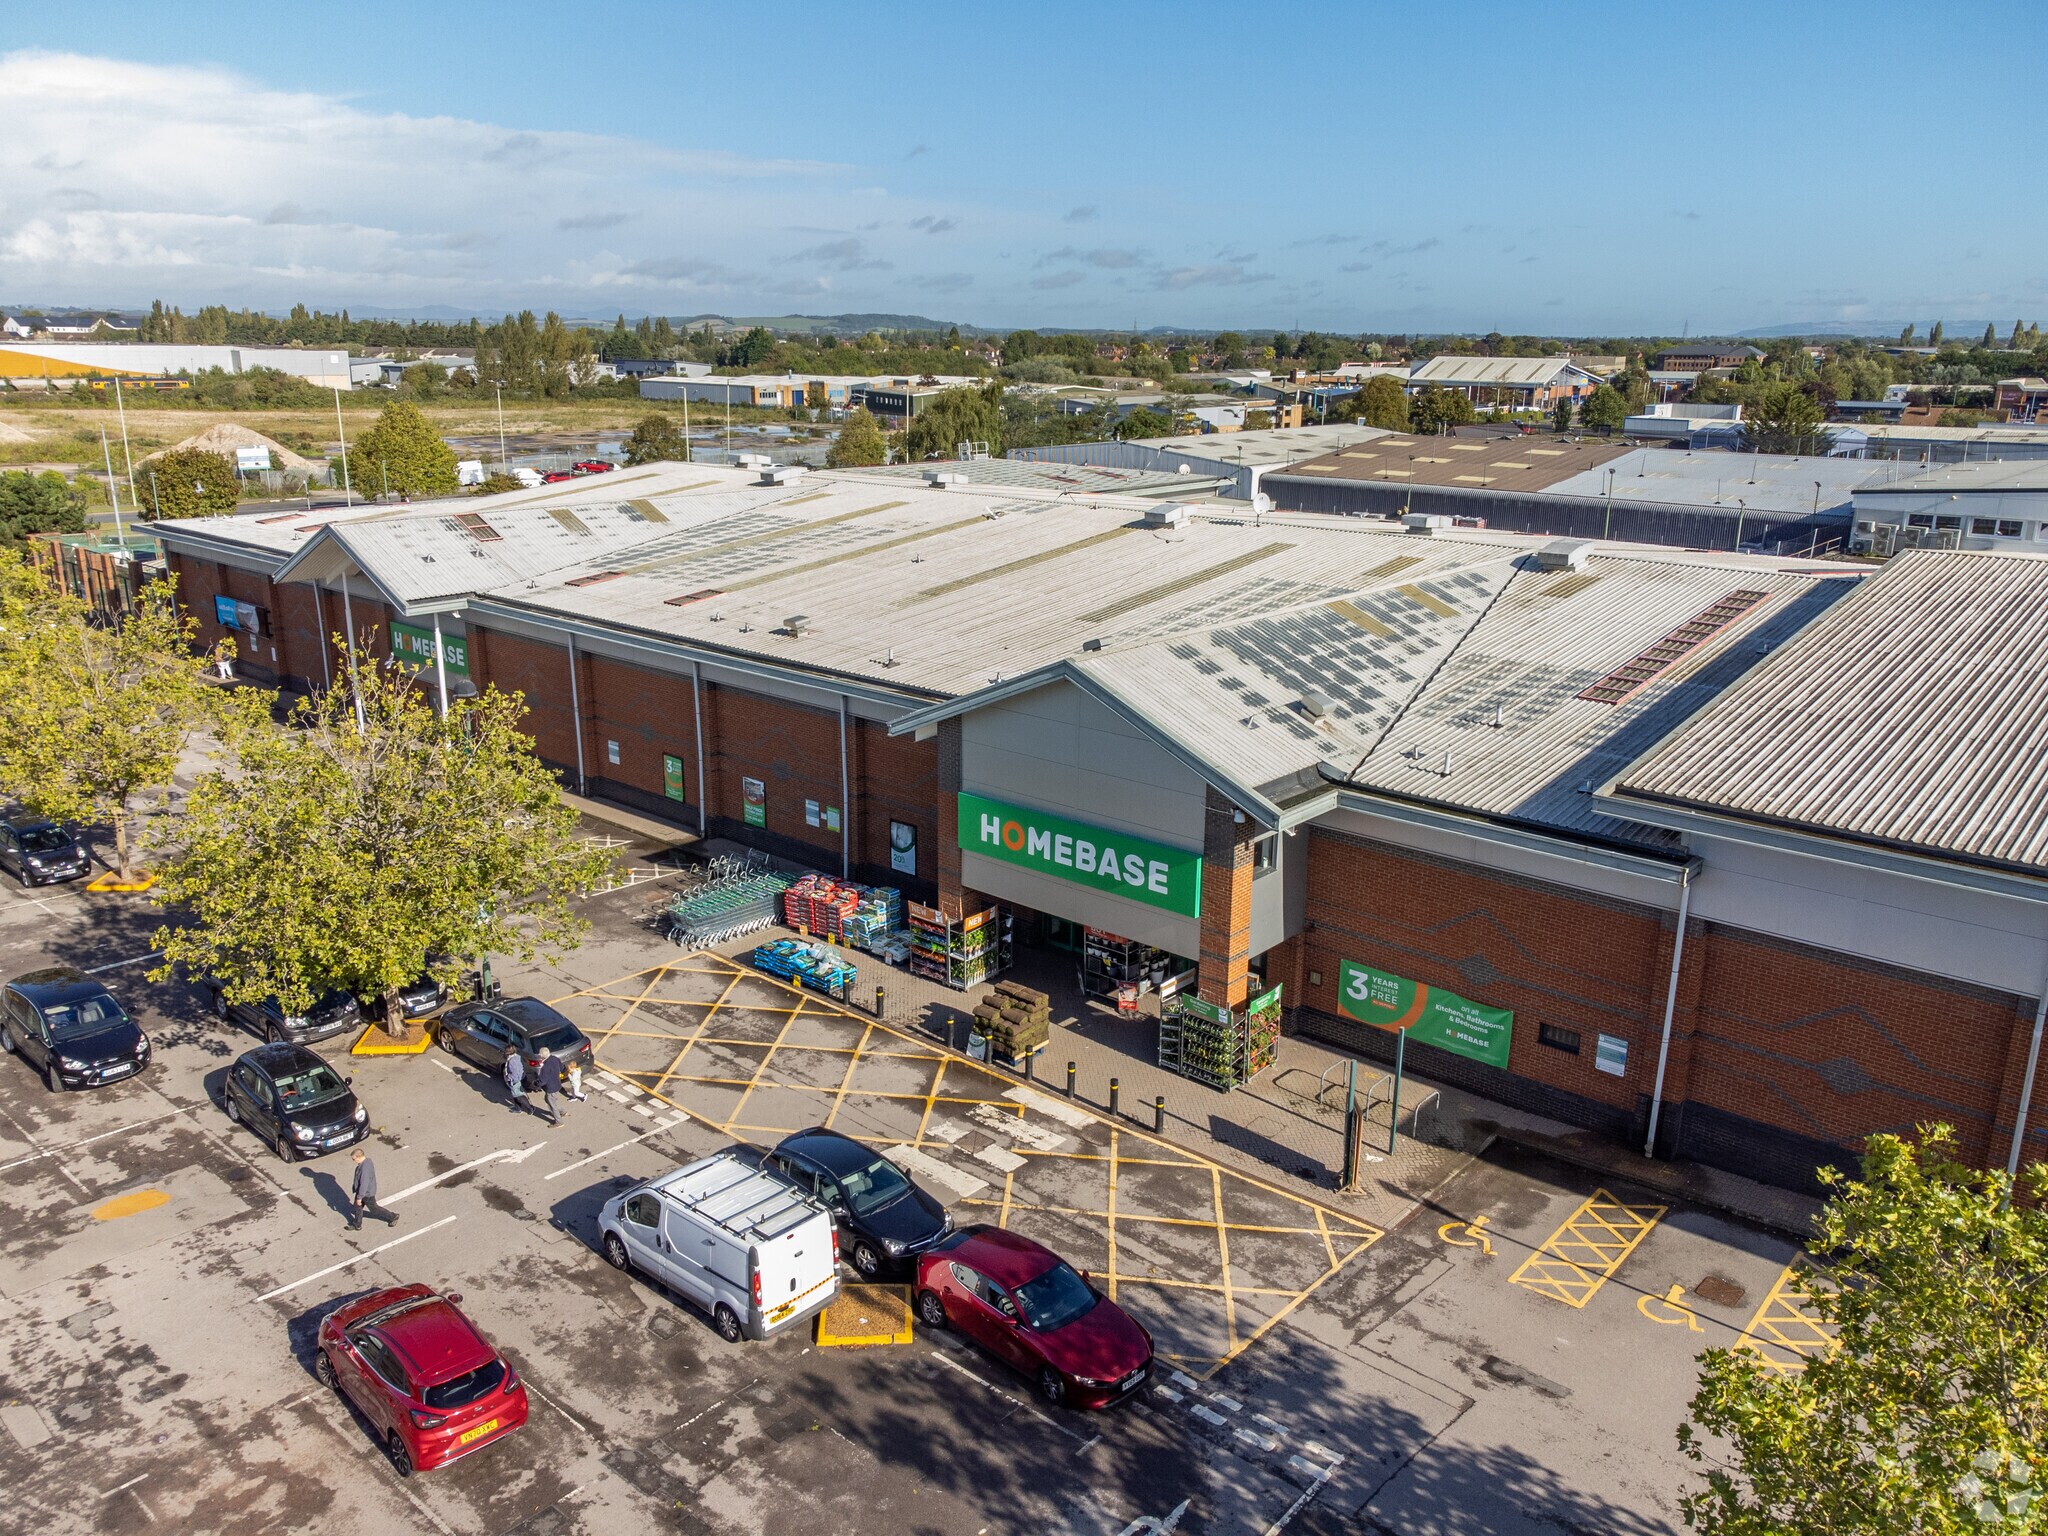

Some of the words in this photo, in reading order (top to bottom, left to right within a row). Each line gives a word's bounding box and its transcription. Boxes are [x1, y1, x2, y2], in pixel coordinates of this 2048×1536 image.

[394, 631, 465, 667] HOMEBSE
[666, 759, 673, 773] 3
[981, 813, 1169, 895] HOMEBASE
[911, 904, 927, 916] NEW
[967, 915, 983, 928] NEW
[1346, 968, 1369, 1001] 3
[1371, 984, 1398, 996] INTEREST
[1372, 976, 1399, 990] YEARS
[1370, 989, 1399, 1005] FREE
[1435, 1003, 1466, 1019] Kitchens,
[1466, 1014, 1505, 1031] Bathrooms
[1470, 1008, 1480, 1016] all
[1455, 1016, 1488, 1034] Bedrooms
[1446, 1028, 1490, 1048] HOMEBASE
[463, 1428, 482, 1441] VN70
